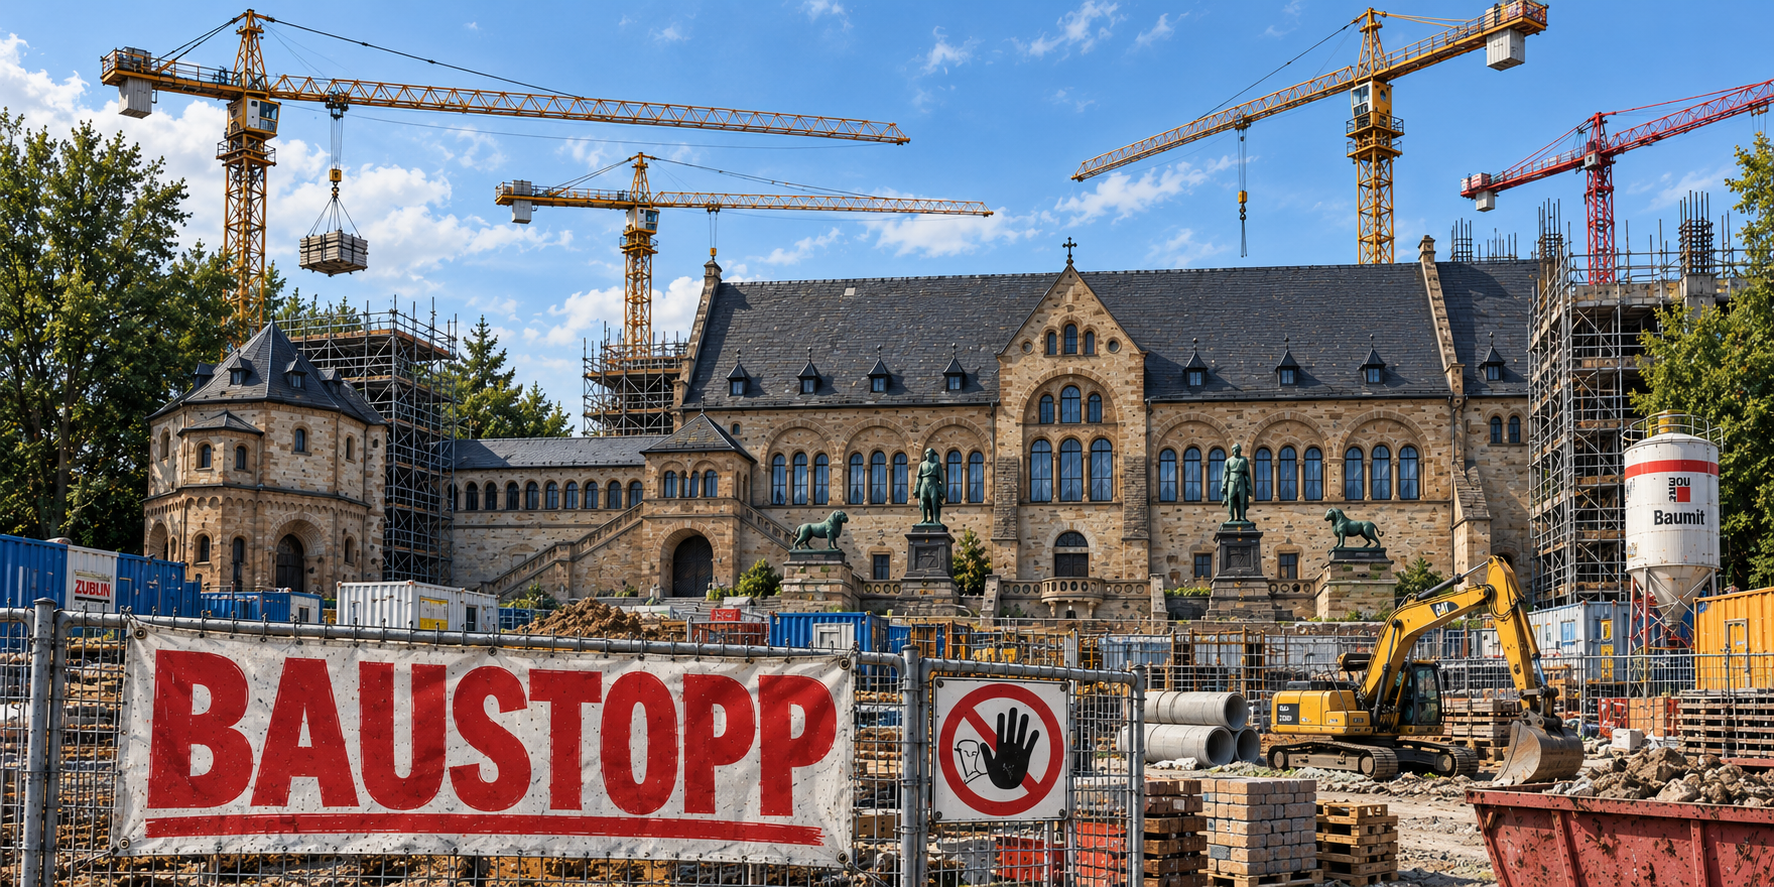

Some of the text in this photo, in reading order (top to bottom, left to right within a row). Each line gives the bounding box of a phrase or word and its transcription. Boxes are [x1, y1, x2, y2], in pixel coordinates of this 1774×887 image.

[1654, 509, 1705, 525] Baumit
[75, 579, 110, 597] ZUBLIN
[147, 649, 837, 816] BAUSTOPP
